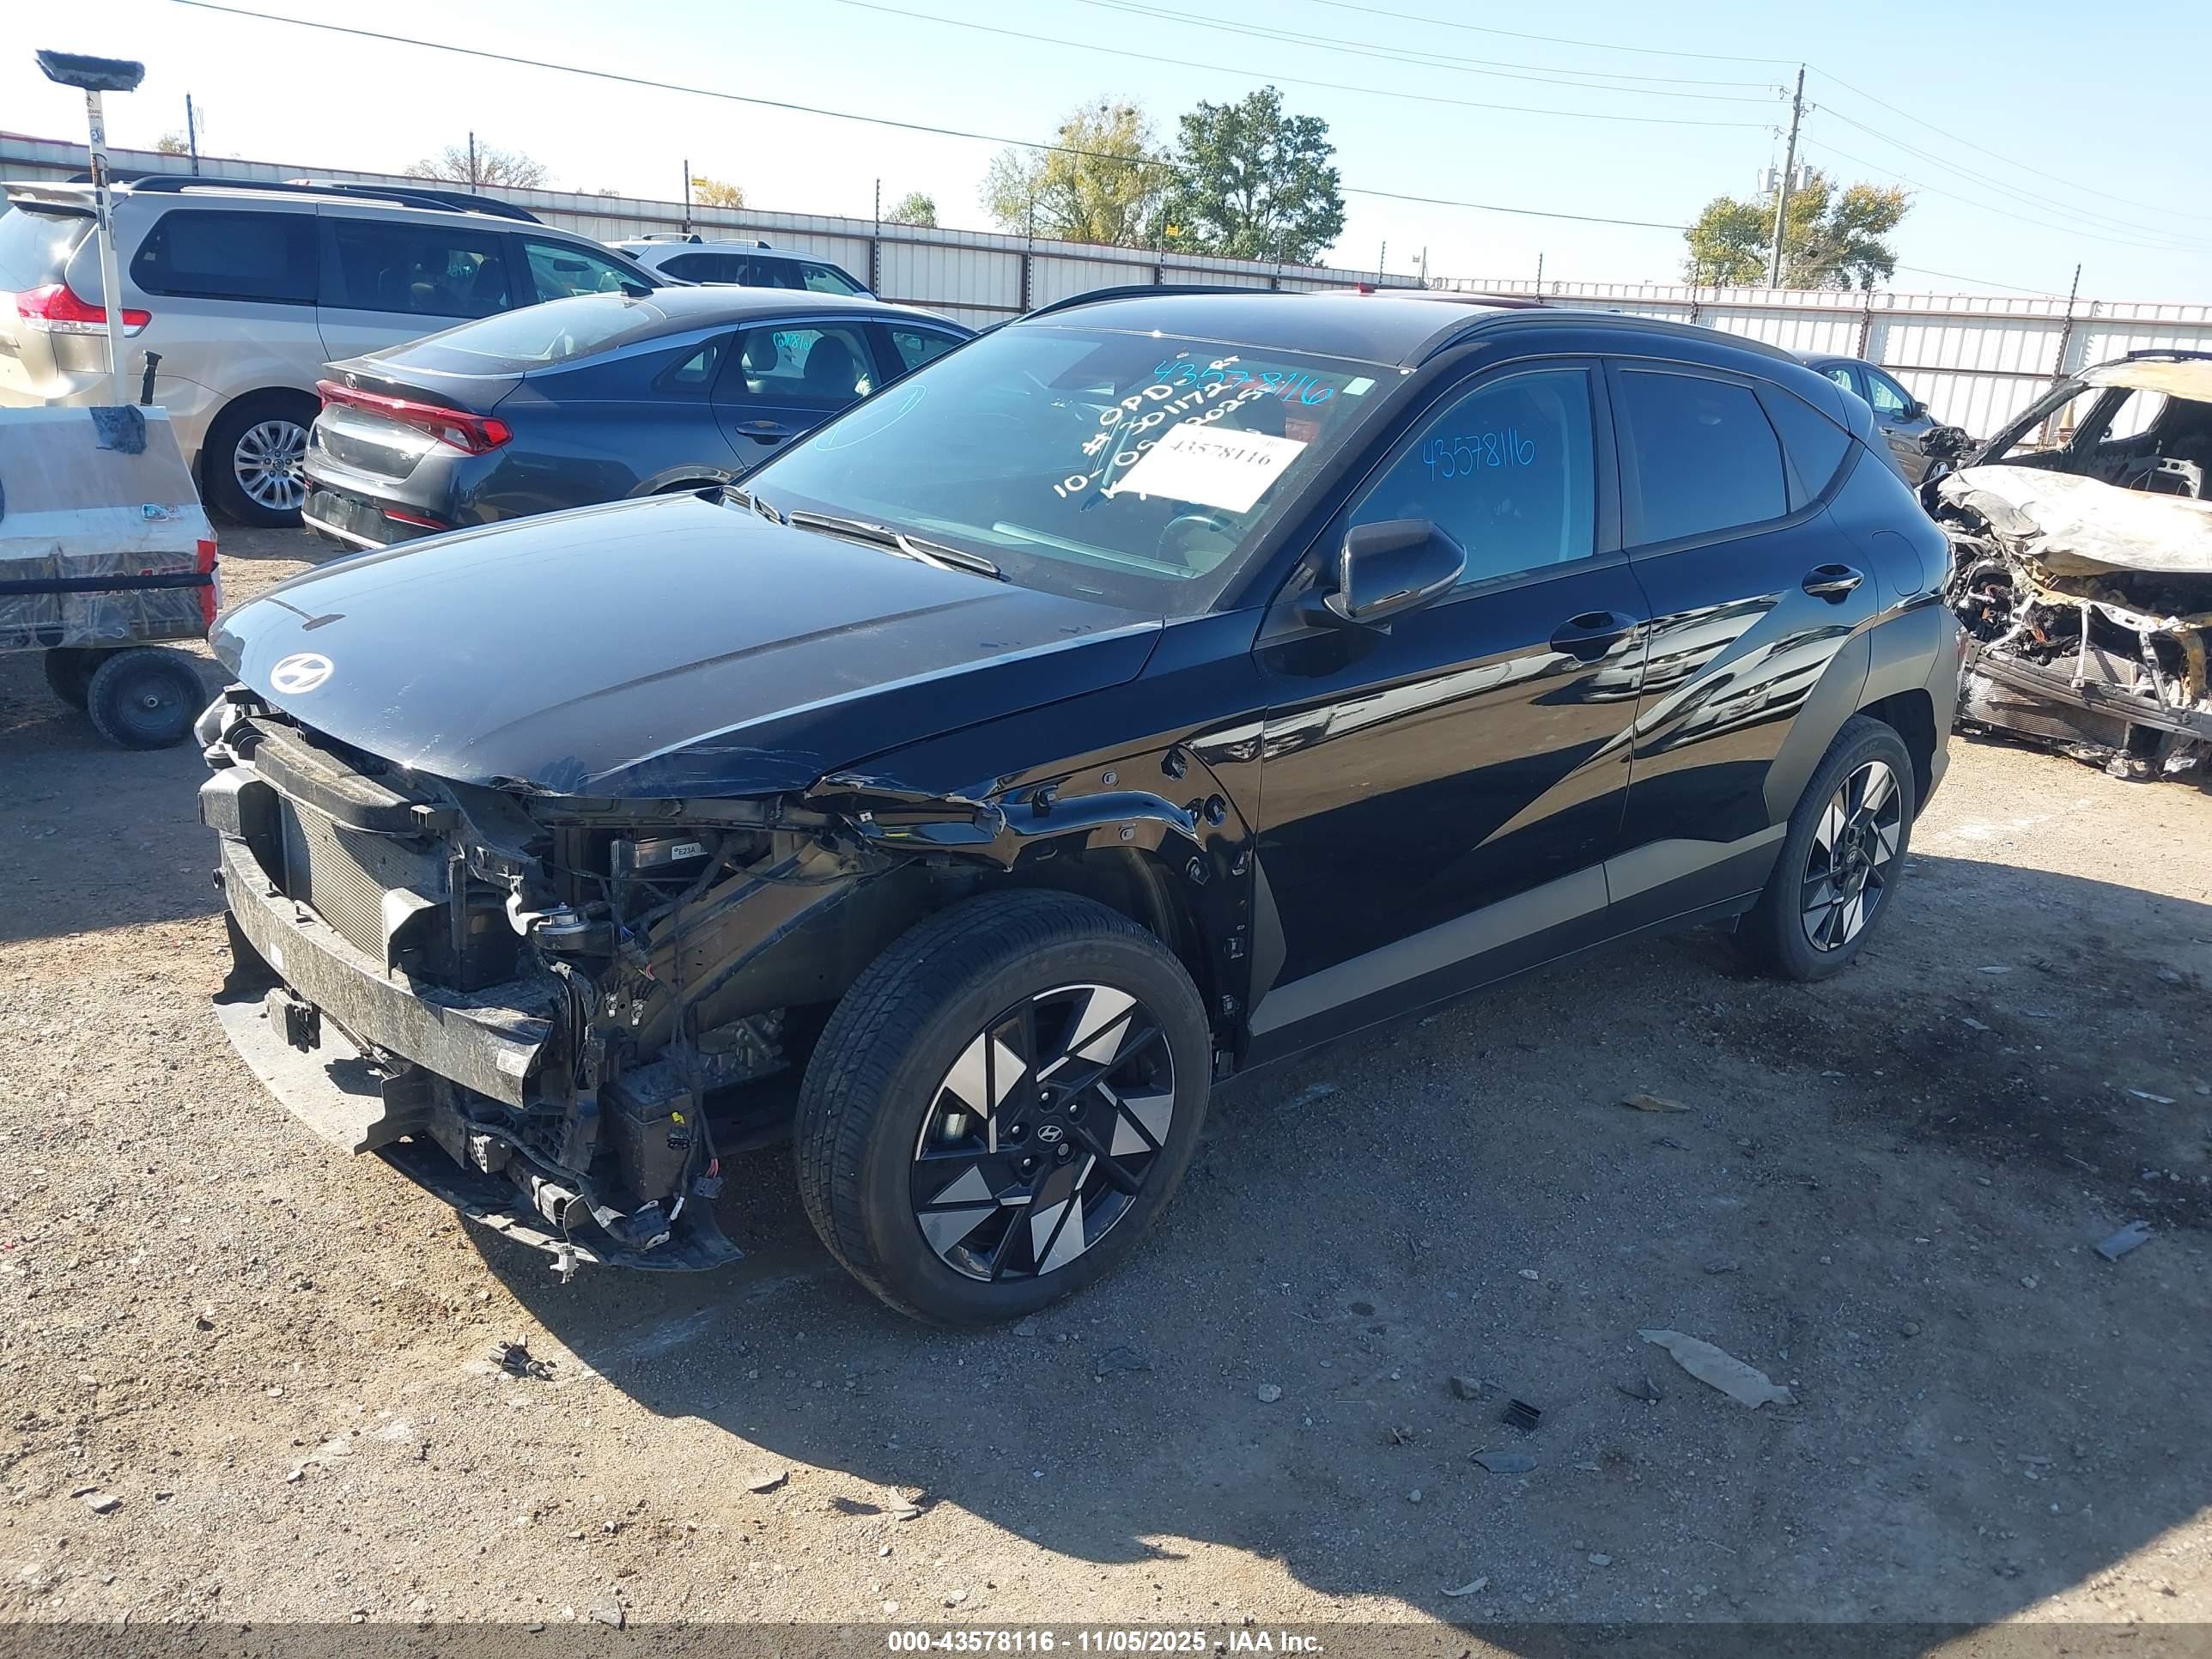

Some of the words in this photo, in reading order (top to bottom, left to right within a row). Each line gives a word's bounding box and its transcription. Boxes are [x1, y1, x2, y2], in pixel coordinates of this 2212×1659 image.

[1154, 360, 1334, 405] 43578116
[1170, 440, 1272, 466] 43578116
[1422, 427, 1534, 481] 43578116
